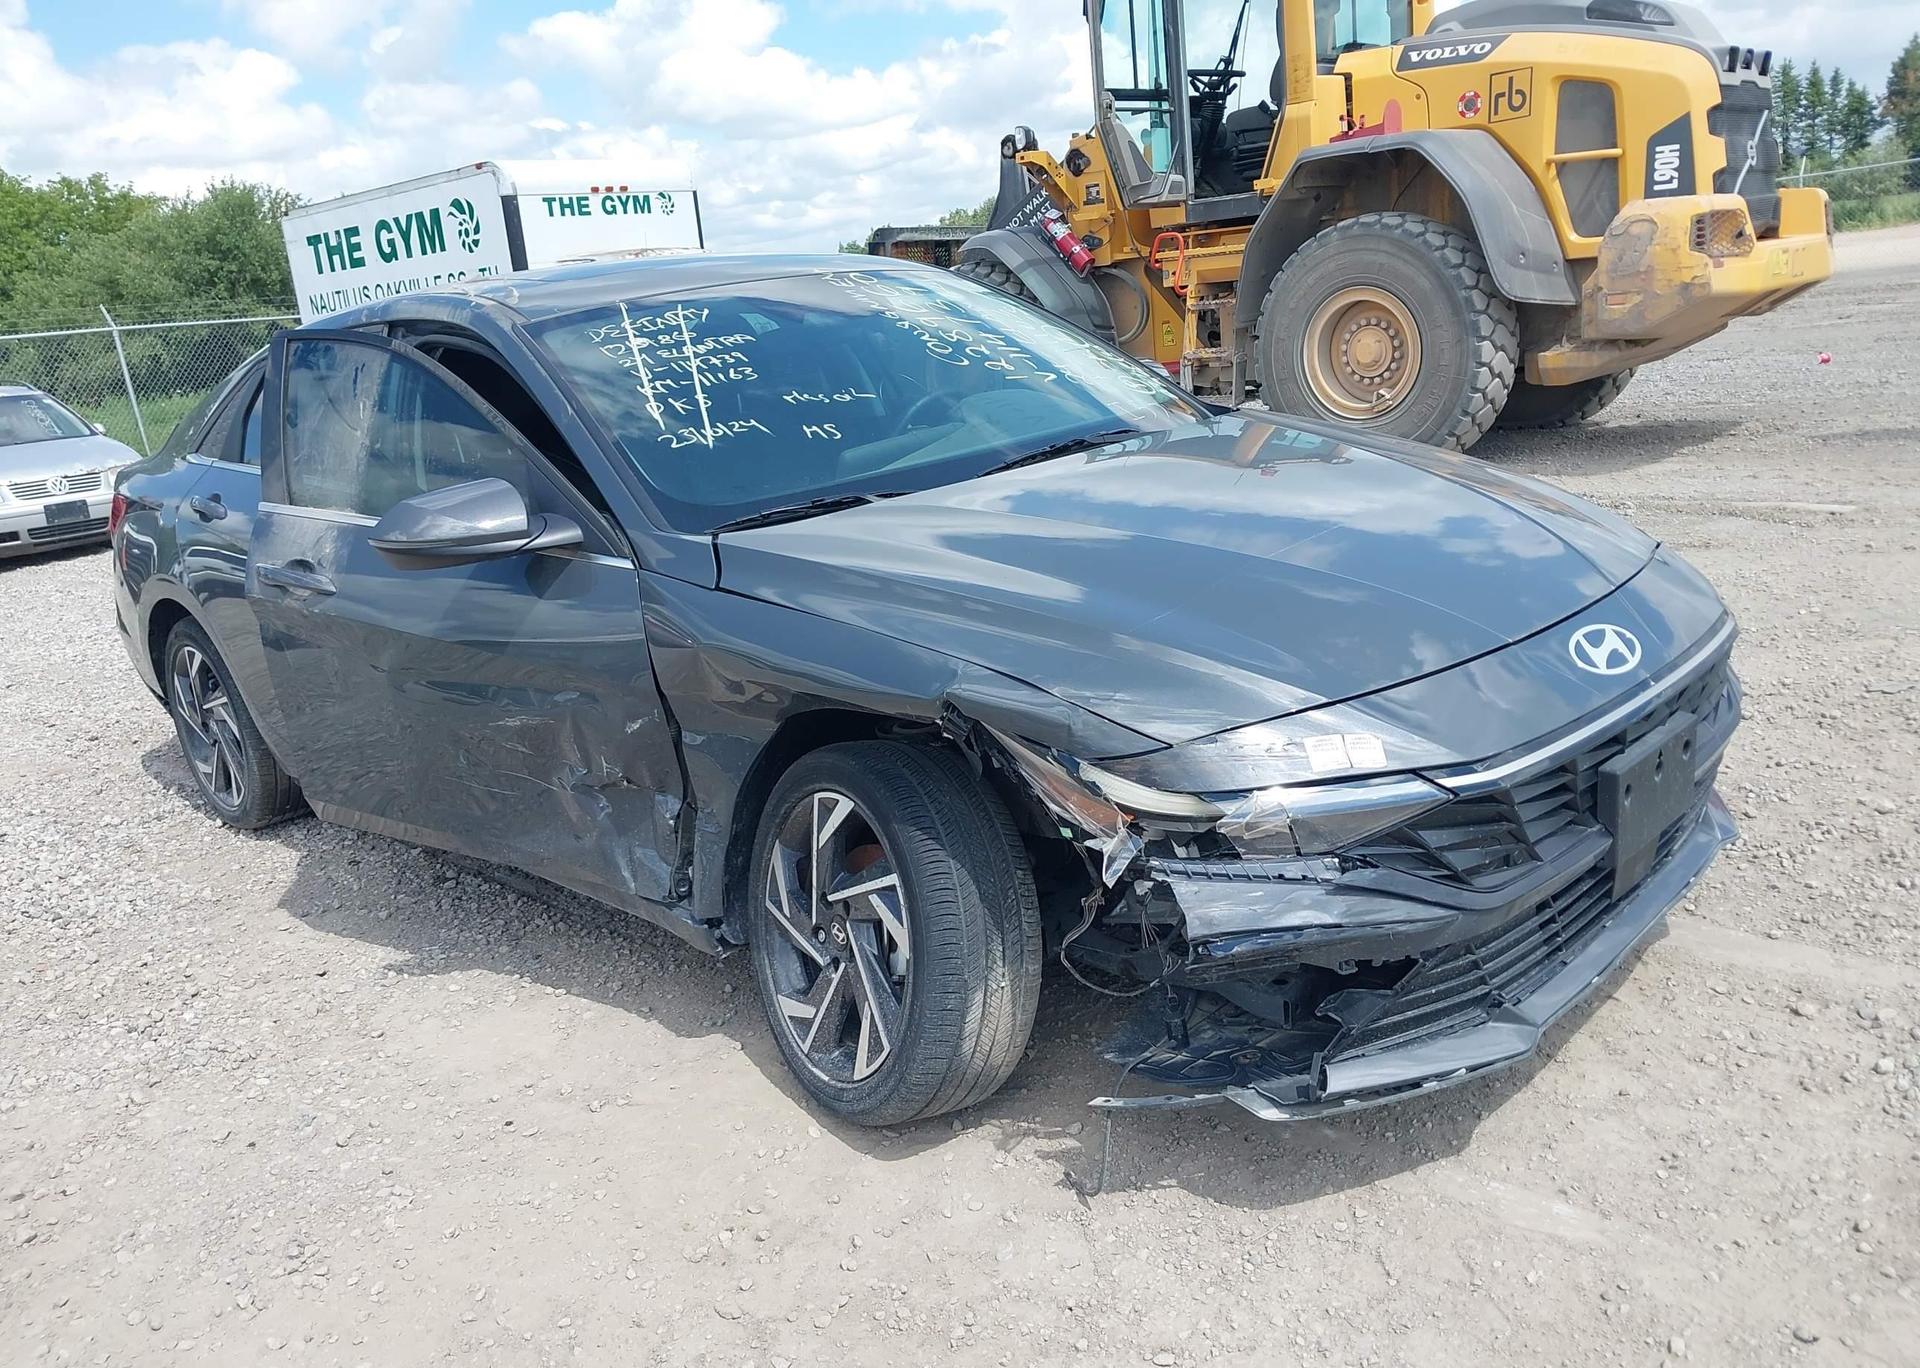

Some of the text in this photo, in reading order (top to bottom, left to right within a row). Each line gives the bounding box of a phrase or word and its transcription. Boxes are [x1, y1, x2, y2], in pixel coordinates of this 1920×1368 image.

[1408, 42, 1492, 62] VOLVO
[1493, 76, 1528, 116] rb
[1653, 144, 1680, 191] L90H
[542, 194, 652, 217] THE GYM
[1023, 187, 1050, 214] WALK
[306, 207, 446, 274] THE GYM
